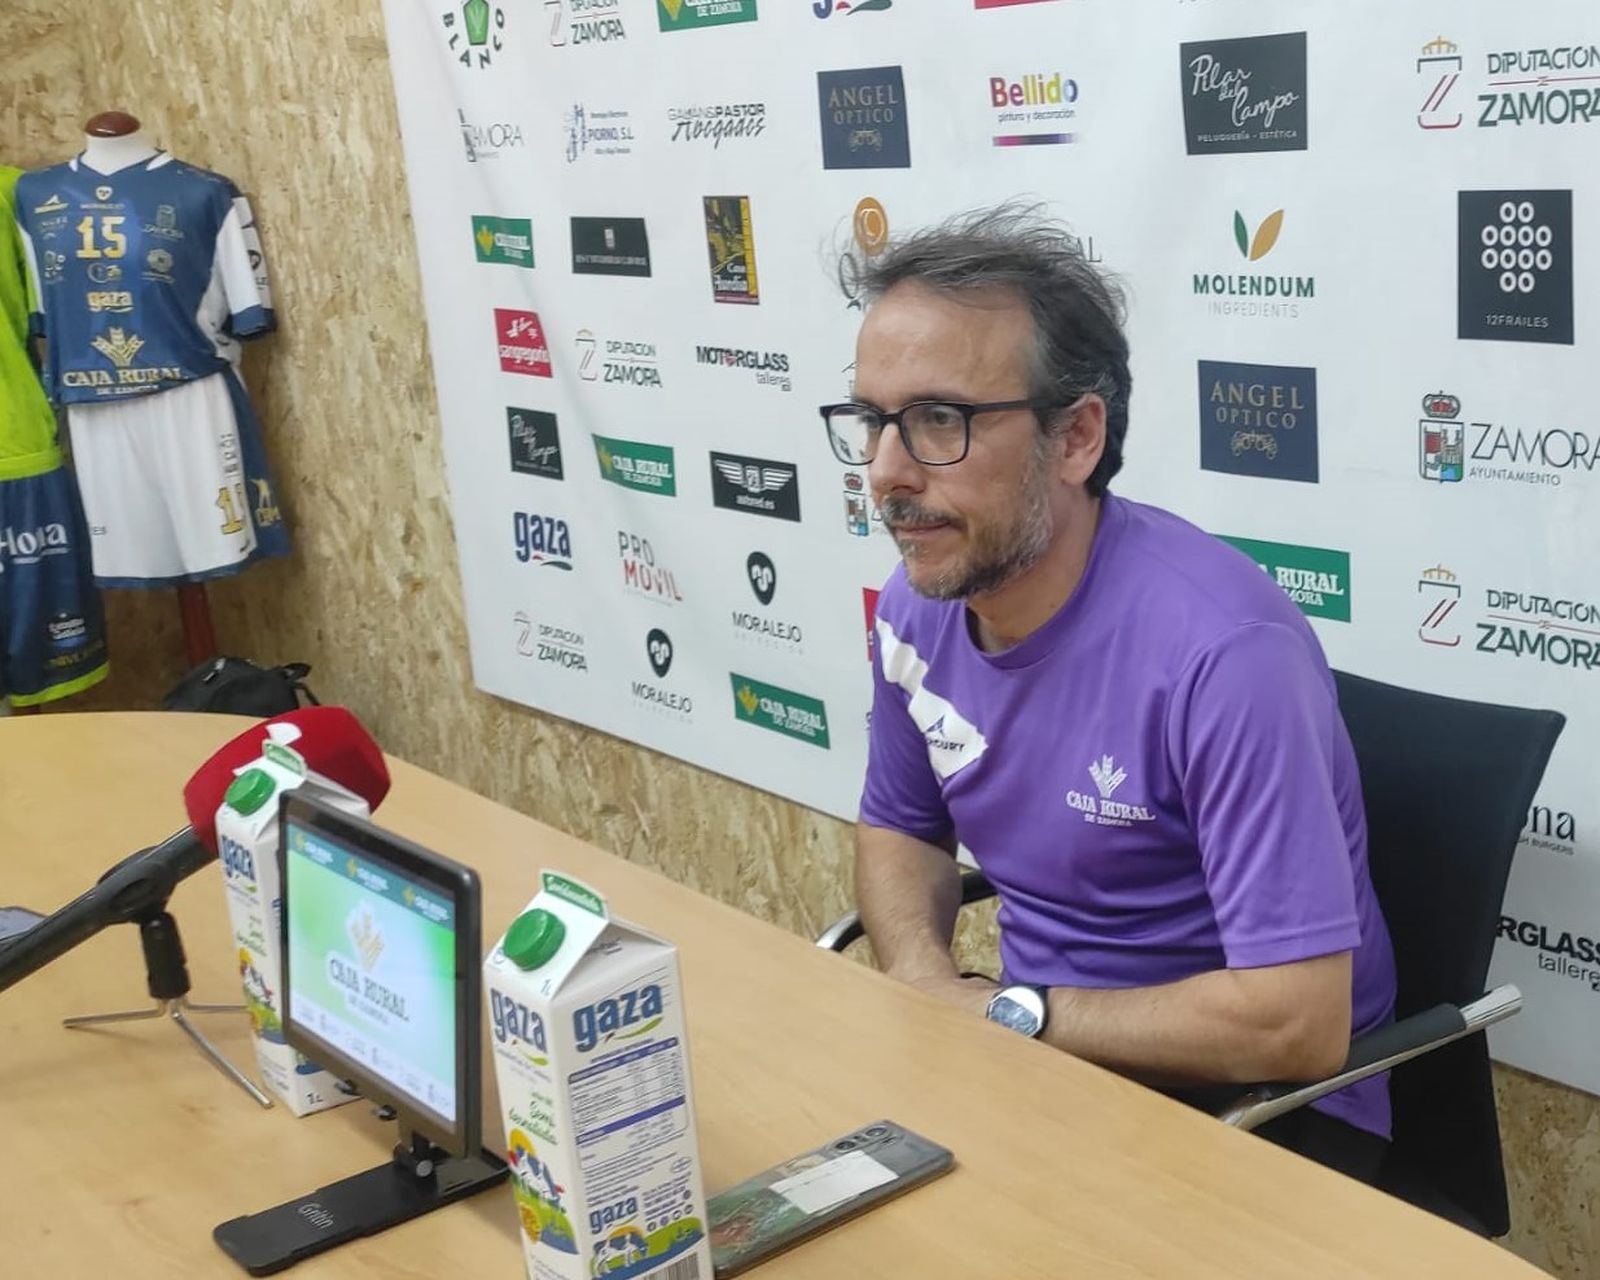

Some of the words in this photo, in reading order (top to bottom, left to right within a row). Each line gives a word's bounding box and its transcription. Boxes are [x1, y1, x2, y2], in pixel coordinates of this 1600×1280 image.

[571, 18, 626, 45] ZAMORA
[828, 84, 898, 108] ANGEL
[989, 72, 1079, 108] Bellido
[76, 215, 127, 259] 15
[1193, 274, 1315, 298] MOLENDUM
[63, 370, 115, 388] CAJA
[603, 362, 663, 389] ZAMORA
[1210, 380, 1305, 411] ANGEL
[1469, 467, 1561, 487] AYUNTAMIENTO
[514, 511, 572, 563] gaza
[618, 531, 655, 567] PRO
[1275, 565, 1345, 596] RURAL
[1285, 588, 1325, 606] MORA
[732, 611, 802, 643] MORALEJO
[536, 643, 588, 673] ZAMORA
[631, 680, 692, 714] MORALEJO
[1066, 790, 1097, 813] CAJA
[1100, 799, 1157, 821] RURAL
[1497, 914, 1600, 967] RGLAS
[1538, 952, 1600, 981] tallere
[490, 987, 548, 1054] gaza
[573, 984, 663, 1053] gaza
[589, 1196, 639, 1235] gaza
